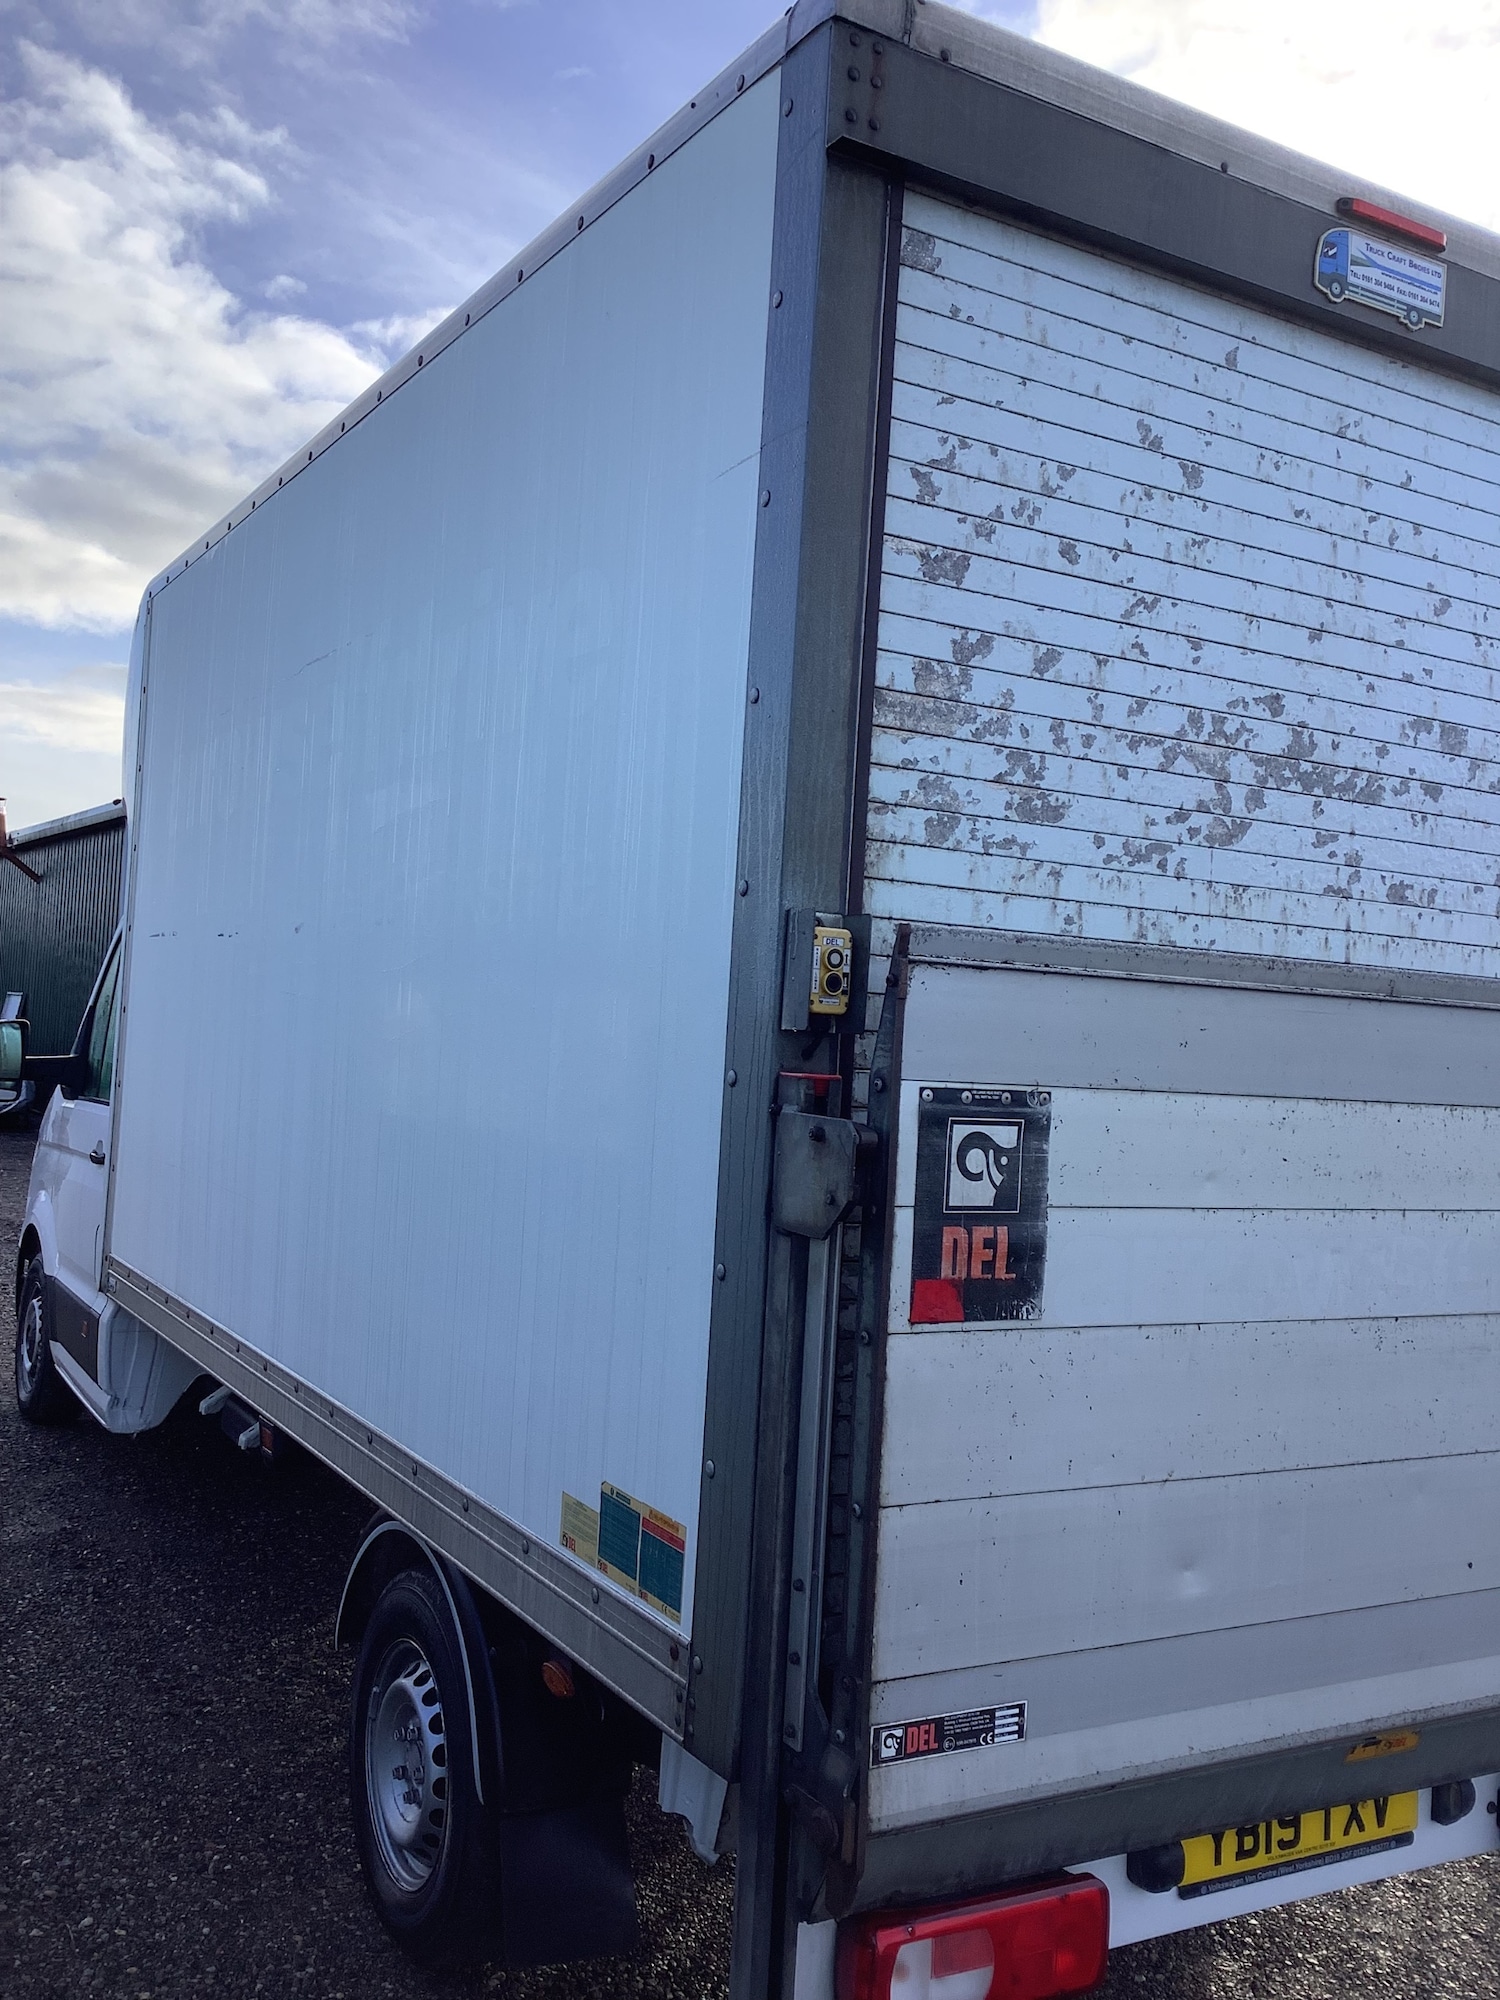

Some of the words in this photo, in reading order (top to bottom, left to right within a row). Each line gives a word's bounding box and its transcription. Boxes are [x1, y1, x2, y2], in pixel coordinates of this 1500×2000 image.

[1365, 242, 1385, 257] TRUCK
[1387, 252, 1406, 265] CRAFT
[1409, 260, 1430, 274] BODIES
[1431, 270, 1442, 278] LTD
[940, 1226, 1016, 1280] DEL
[906, 1723, 938, 1754] DEL
[1208, 1878, 1243, 1892] Volkswagen
[1257, 1870, 1277, 1880] Centre
